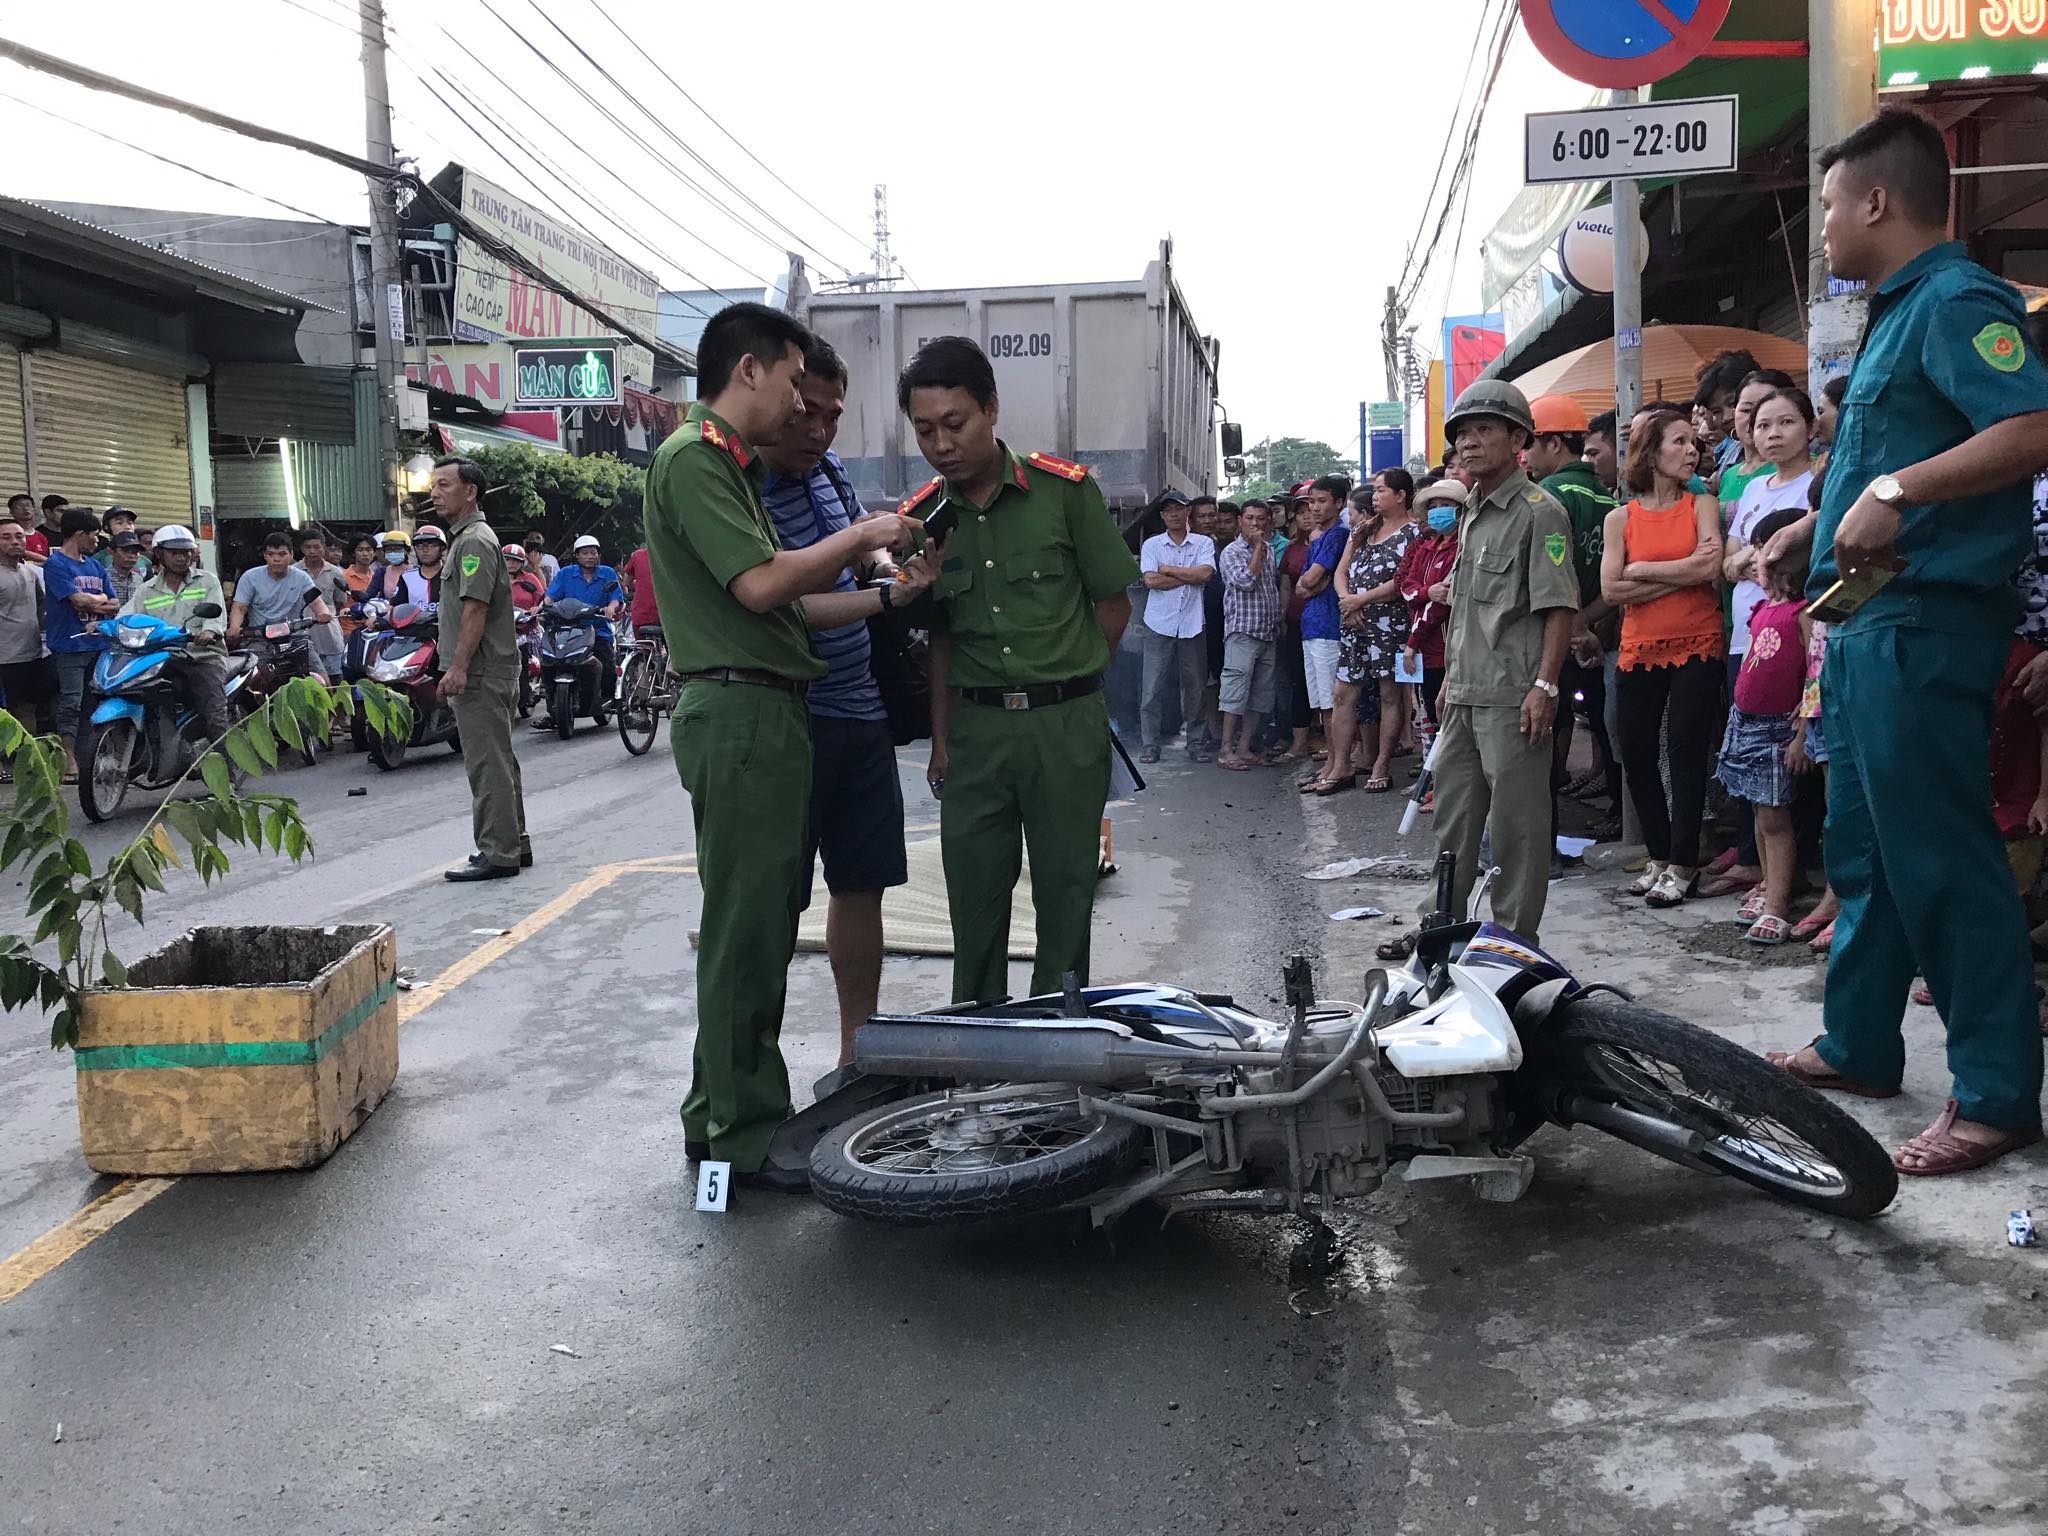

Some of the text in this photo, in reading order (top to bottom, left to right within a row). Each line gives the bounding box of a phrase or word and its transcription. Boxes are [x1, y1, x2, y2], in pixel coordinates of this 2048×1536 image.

[471, 187, 508, 225] TRUNG
[510, 207, 532, 237] TÂM
[533, 222, 565, 253] TRANG
[465, 292, 484, 317] CAO
[990, 333, 1051, 358] 092.09
[405, 354, 500, 400] ÀN
[519, 351, 613, 399] MÀN CỬA
[707, 1170, 719, 1203] 5
